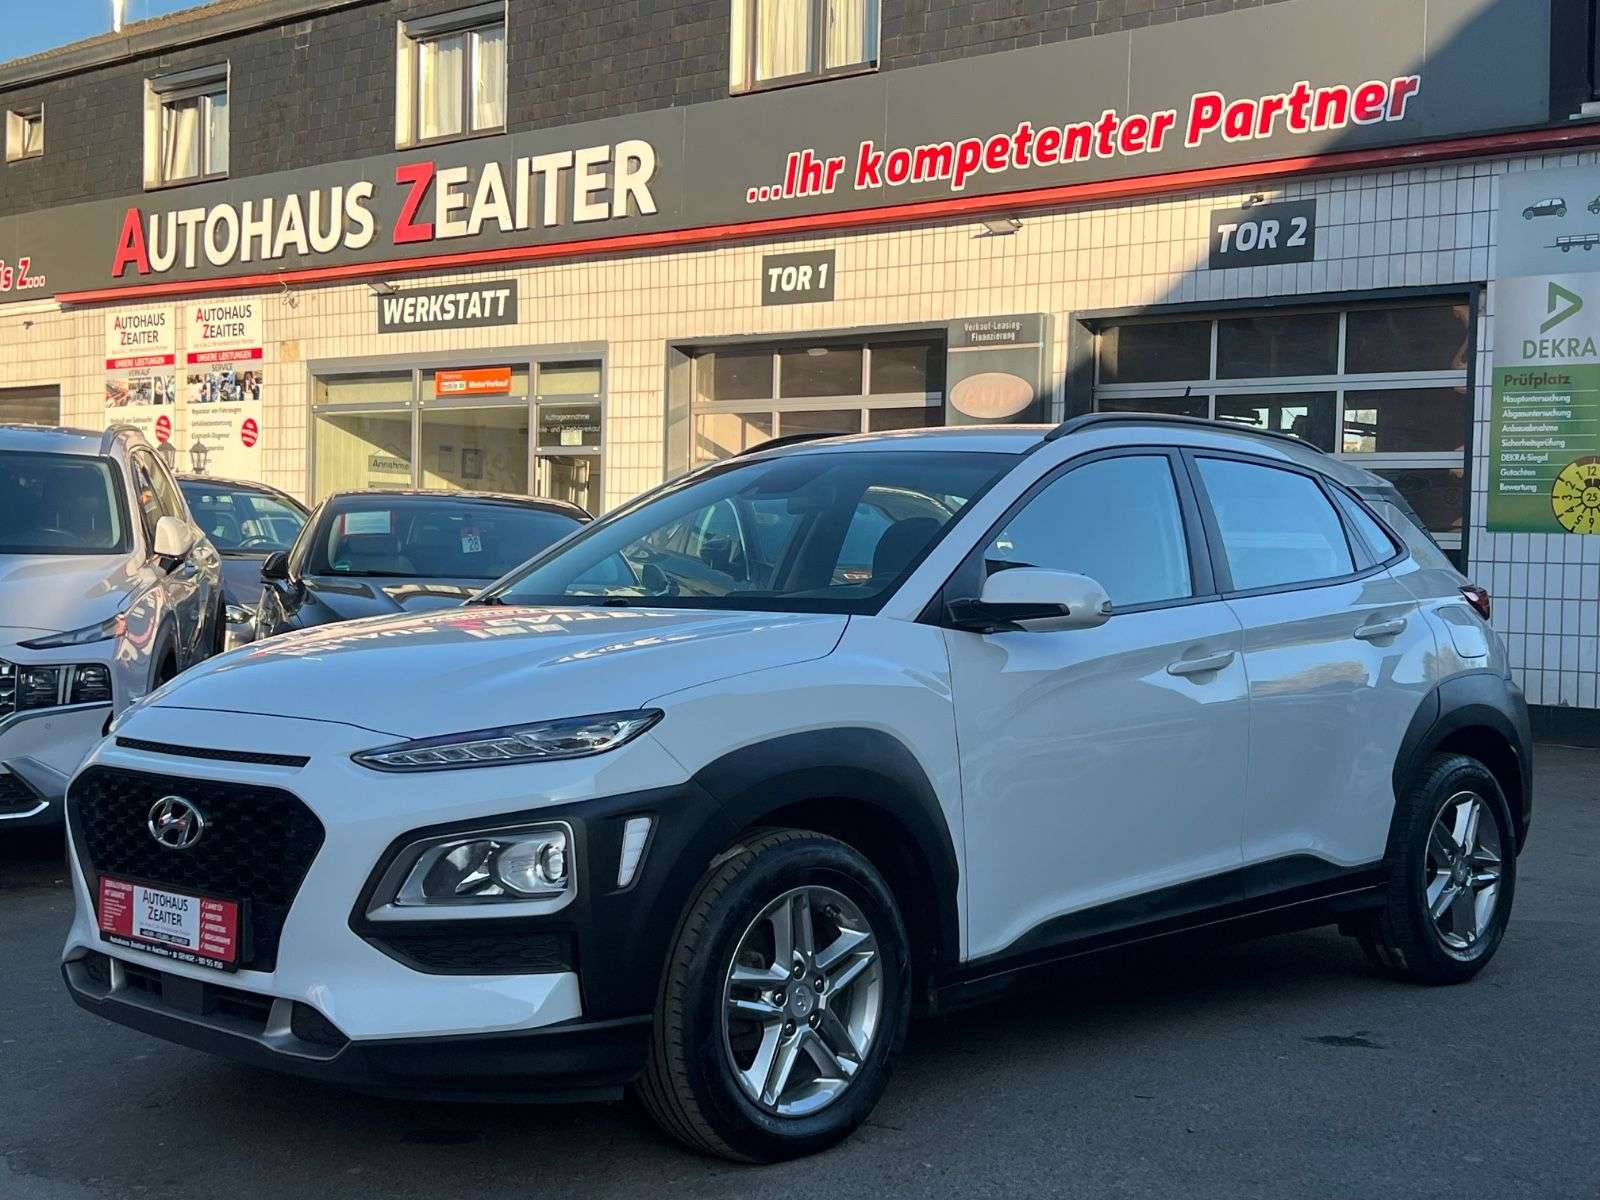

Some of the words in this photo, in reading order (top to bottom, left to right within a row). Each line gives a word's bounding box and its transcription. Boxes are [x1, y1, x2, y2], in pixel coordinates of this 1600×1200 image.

[746, 149, 846, 203] ...Ihr
[854, 109, 1176, 192] kompetenter
[1184, 74, 1420, 148] Partner
[112, 181, 375, 277] AUTOHAUS
[393, 140, 657, 244] ZEAITER
[1217, 219, 1280, 254] TOR
[1287, 216, 1307, 248] 2
[768, 264, 812, 293] TOR
[817, 263, 828, 289] 1
[196, 304, 252, 323] AUTOHAUS
[383, 288, 510, 325] WERKSTATT
[114, 313, 165, 331] AUTOHAUS
[120, 330, 159, 346] ZEAITER
[203, 322, 245, 339] ZEAITER
[971, 332, 1015, 341] Finanzierung
[1522, 337, 1598, 359] DEKRA
[1504, 372, 1570, 388] Prüfplatz
[1502, 394, 1571, 405] Hauptuntersuchung
[1501, 438, 1566, 448] Sicherheitsprüfung
[372, 458, 410, 470] Annahme
[1501, 453, 1549, 463] DEKRA-Siegel
[1500, 467, 1536, 476] Gutachten
[1587, 465, 1597, 477] 12
[1500, 482, 1537, 492] Bewertung
[1586, 492, 1598, 502] 25
[143, 889, 188, 912] AUTOHAUS
[148, 906, 183, 926] ZEAITER
